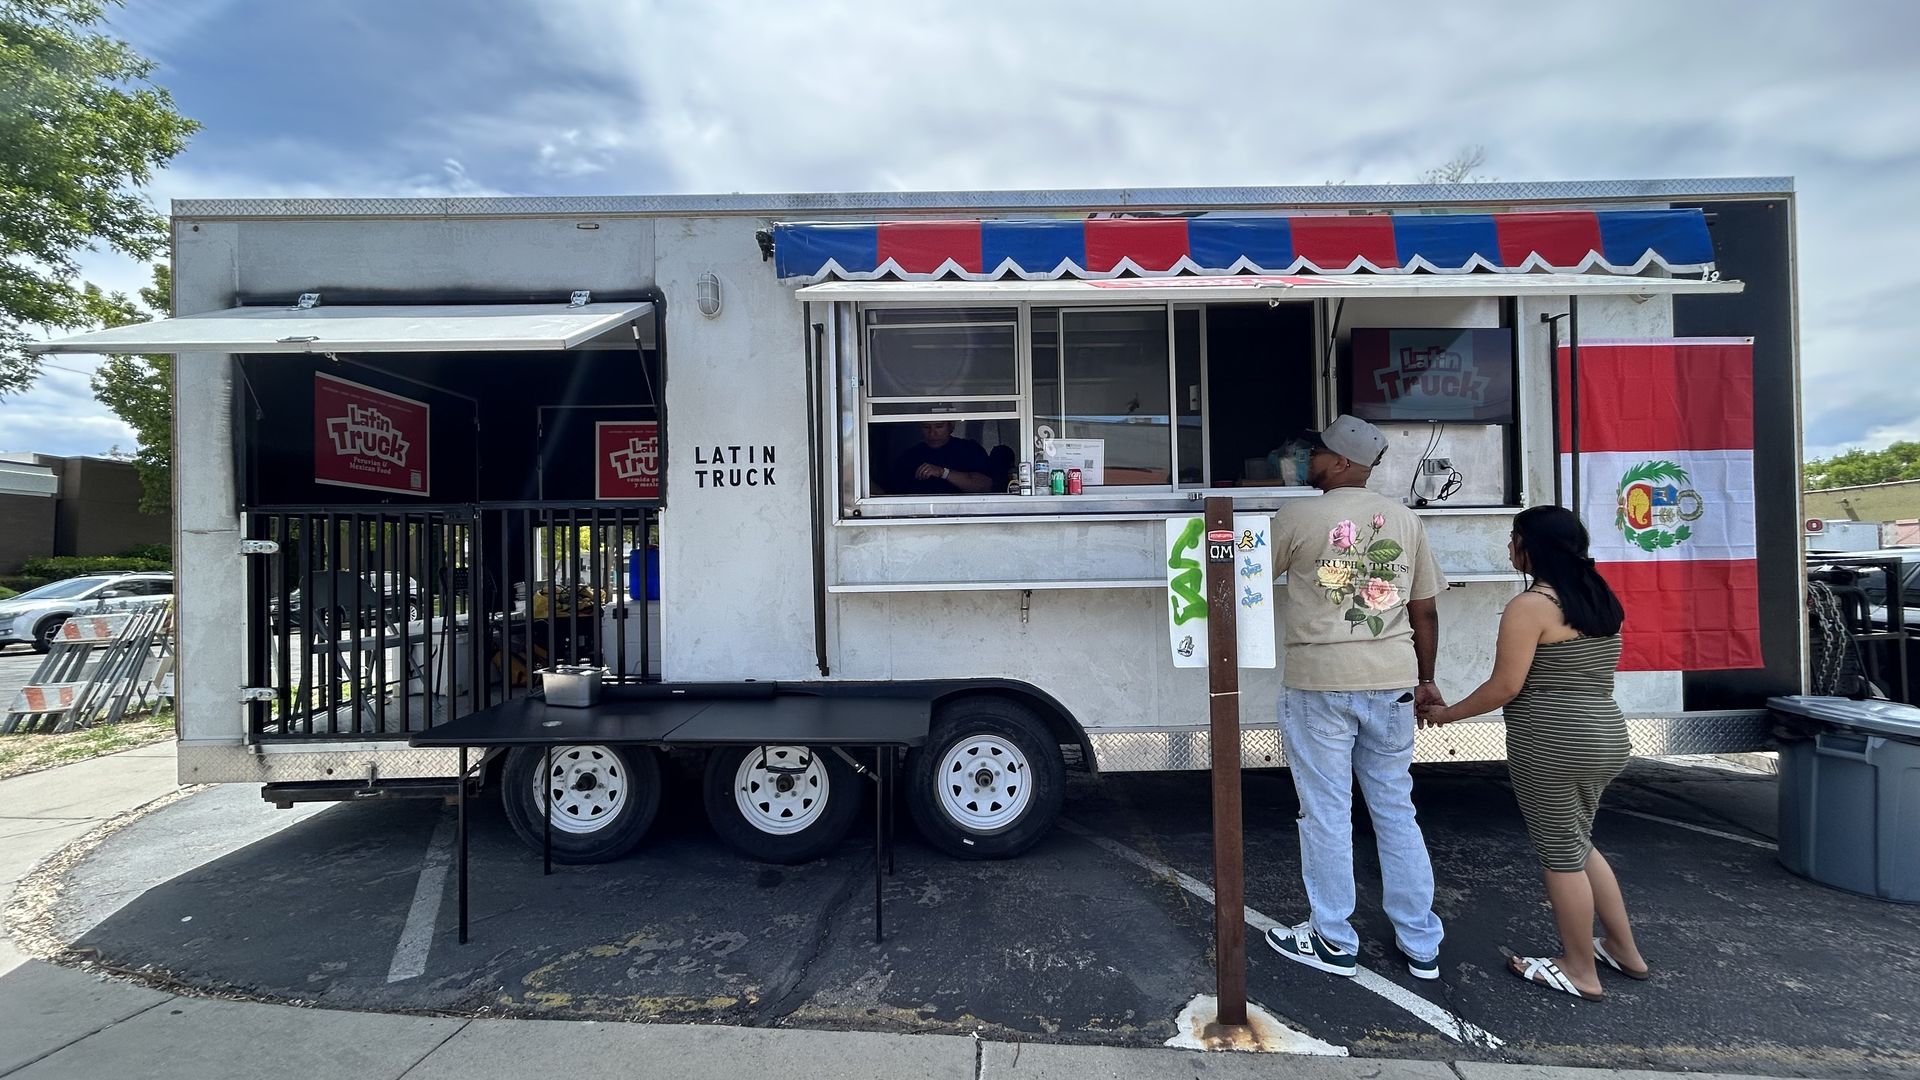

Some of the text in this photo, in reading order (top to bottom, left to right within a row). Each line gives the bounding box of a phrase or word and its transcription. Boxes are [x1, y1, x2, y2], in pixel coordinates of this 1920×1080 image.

[1402, 347, 1462, 371] Latin
[1376, 367, 1486, 405] Truck
[348, 405, 391, 433] Latin
[328, 419, 408, 464] Truck
[695, 445, 776, 464] LATIN
[695, 467, 776, 488] TRUCK
